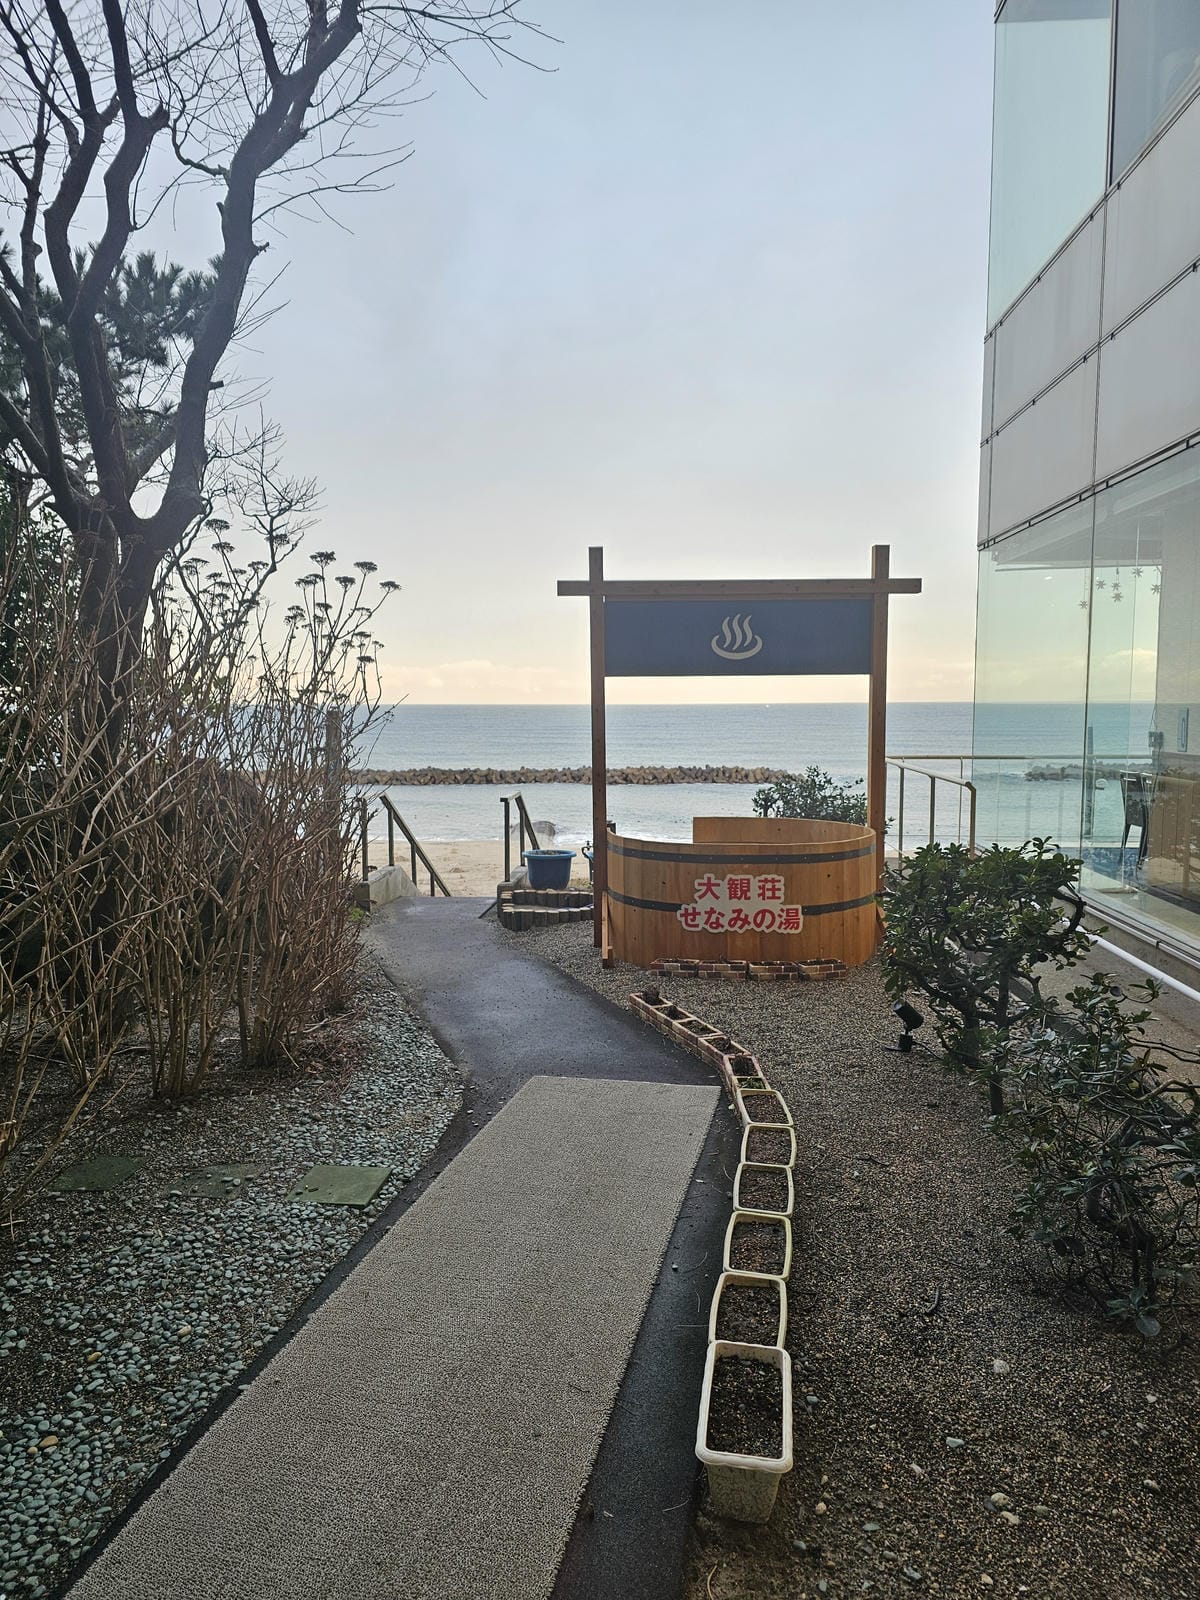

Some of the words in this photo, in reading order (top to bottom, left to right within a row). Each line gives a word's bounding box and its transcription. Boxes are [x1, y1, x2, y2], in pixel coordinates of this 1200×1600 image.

[697, 876, 782, 901] 大観荘
[679, 906, 801, 931] せなみの湯
